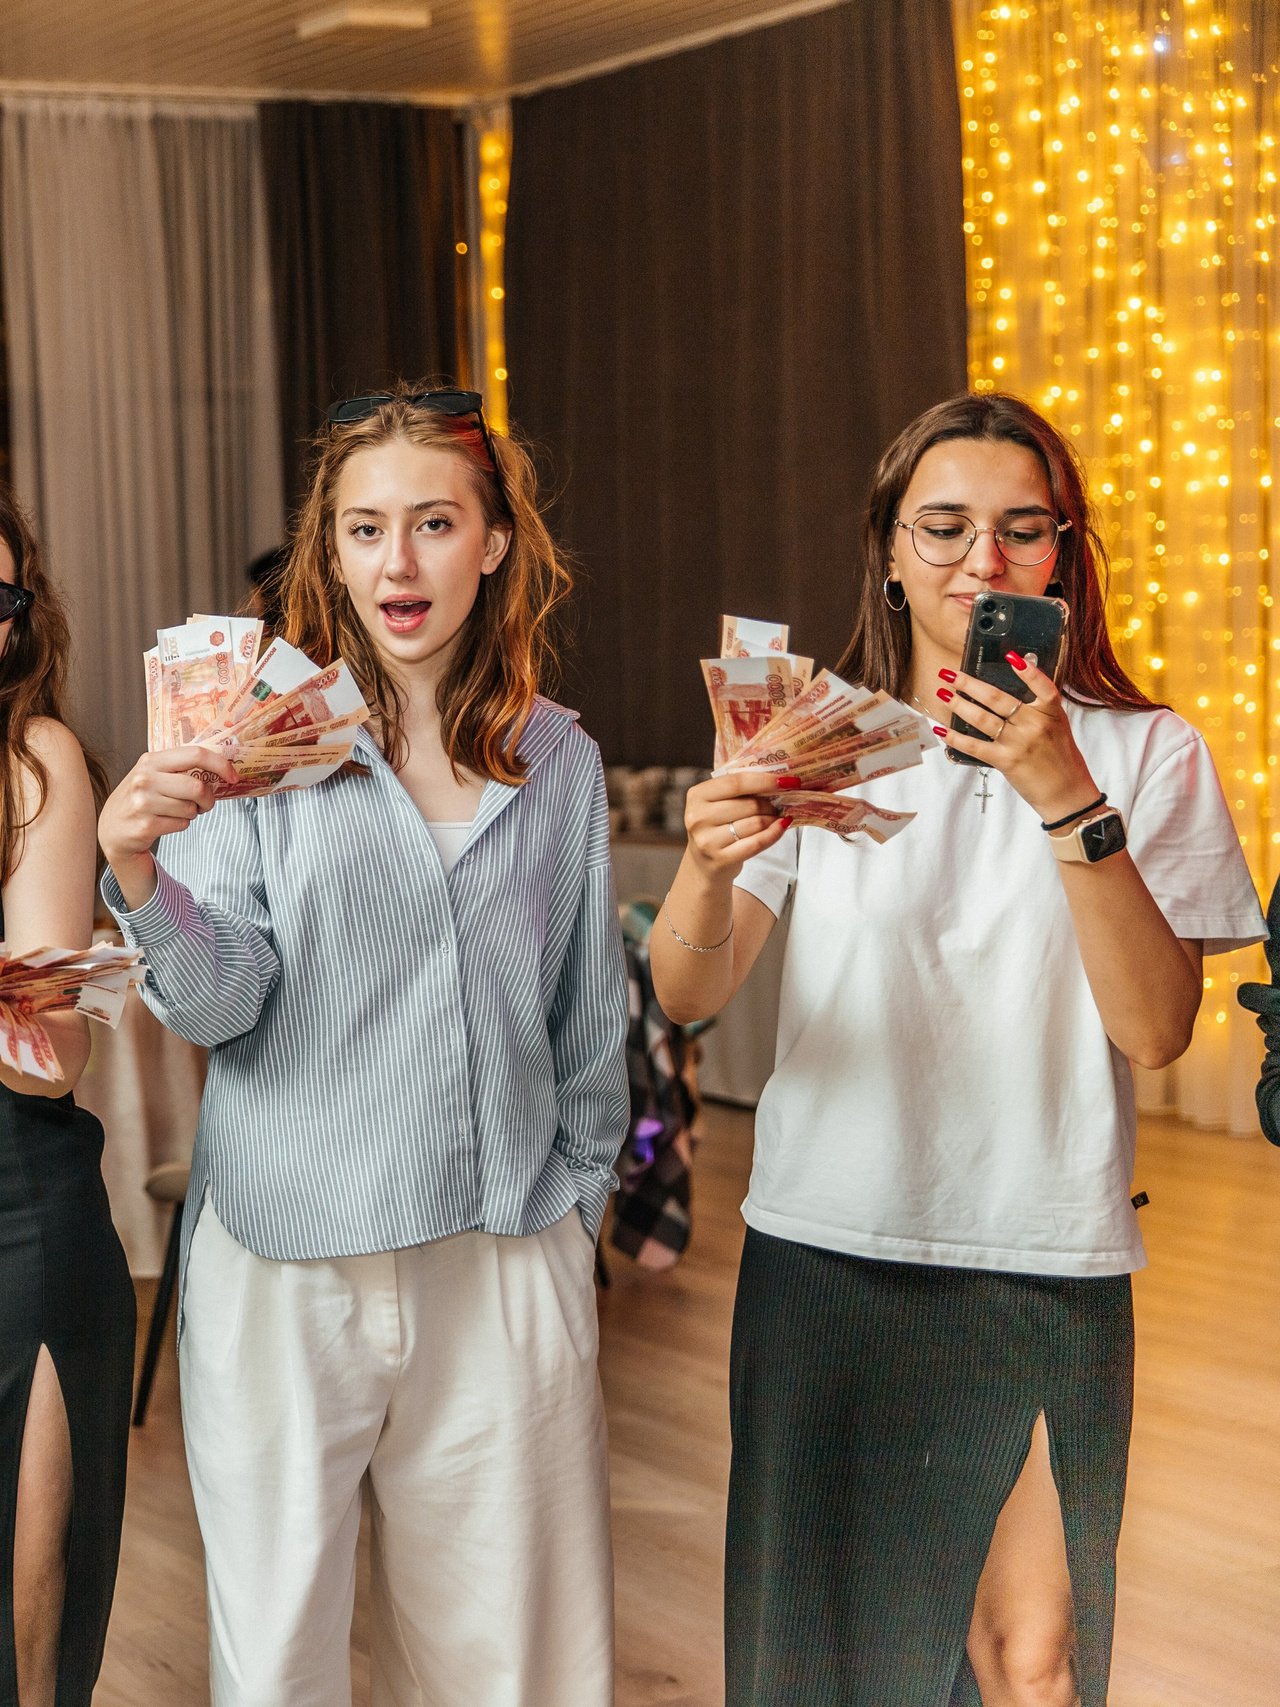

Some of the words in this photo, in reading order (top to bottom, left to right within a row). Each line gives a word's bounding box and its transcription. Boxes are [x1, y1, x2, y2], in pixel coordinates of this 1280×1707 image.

[216, 652, 230, 685] 5000
[254, 647, 277, 677] ПРИКОЛОВ
[766, 674, 786, 708] 5000
